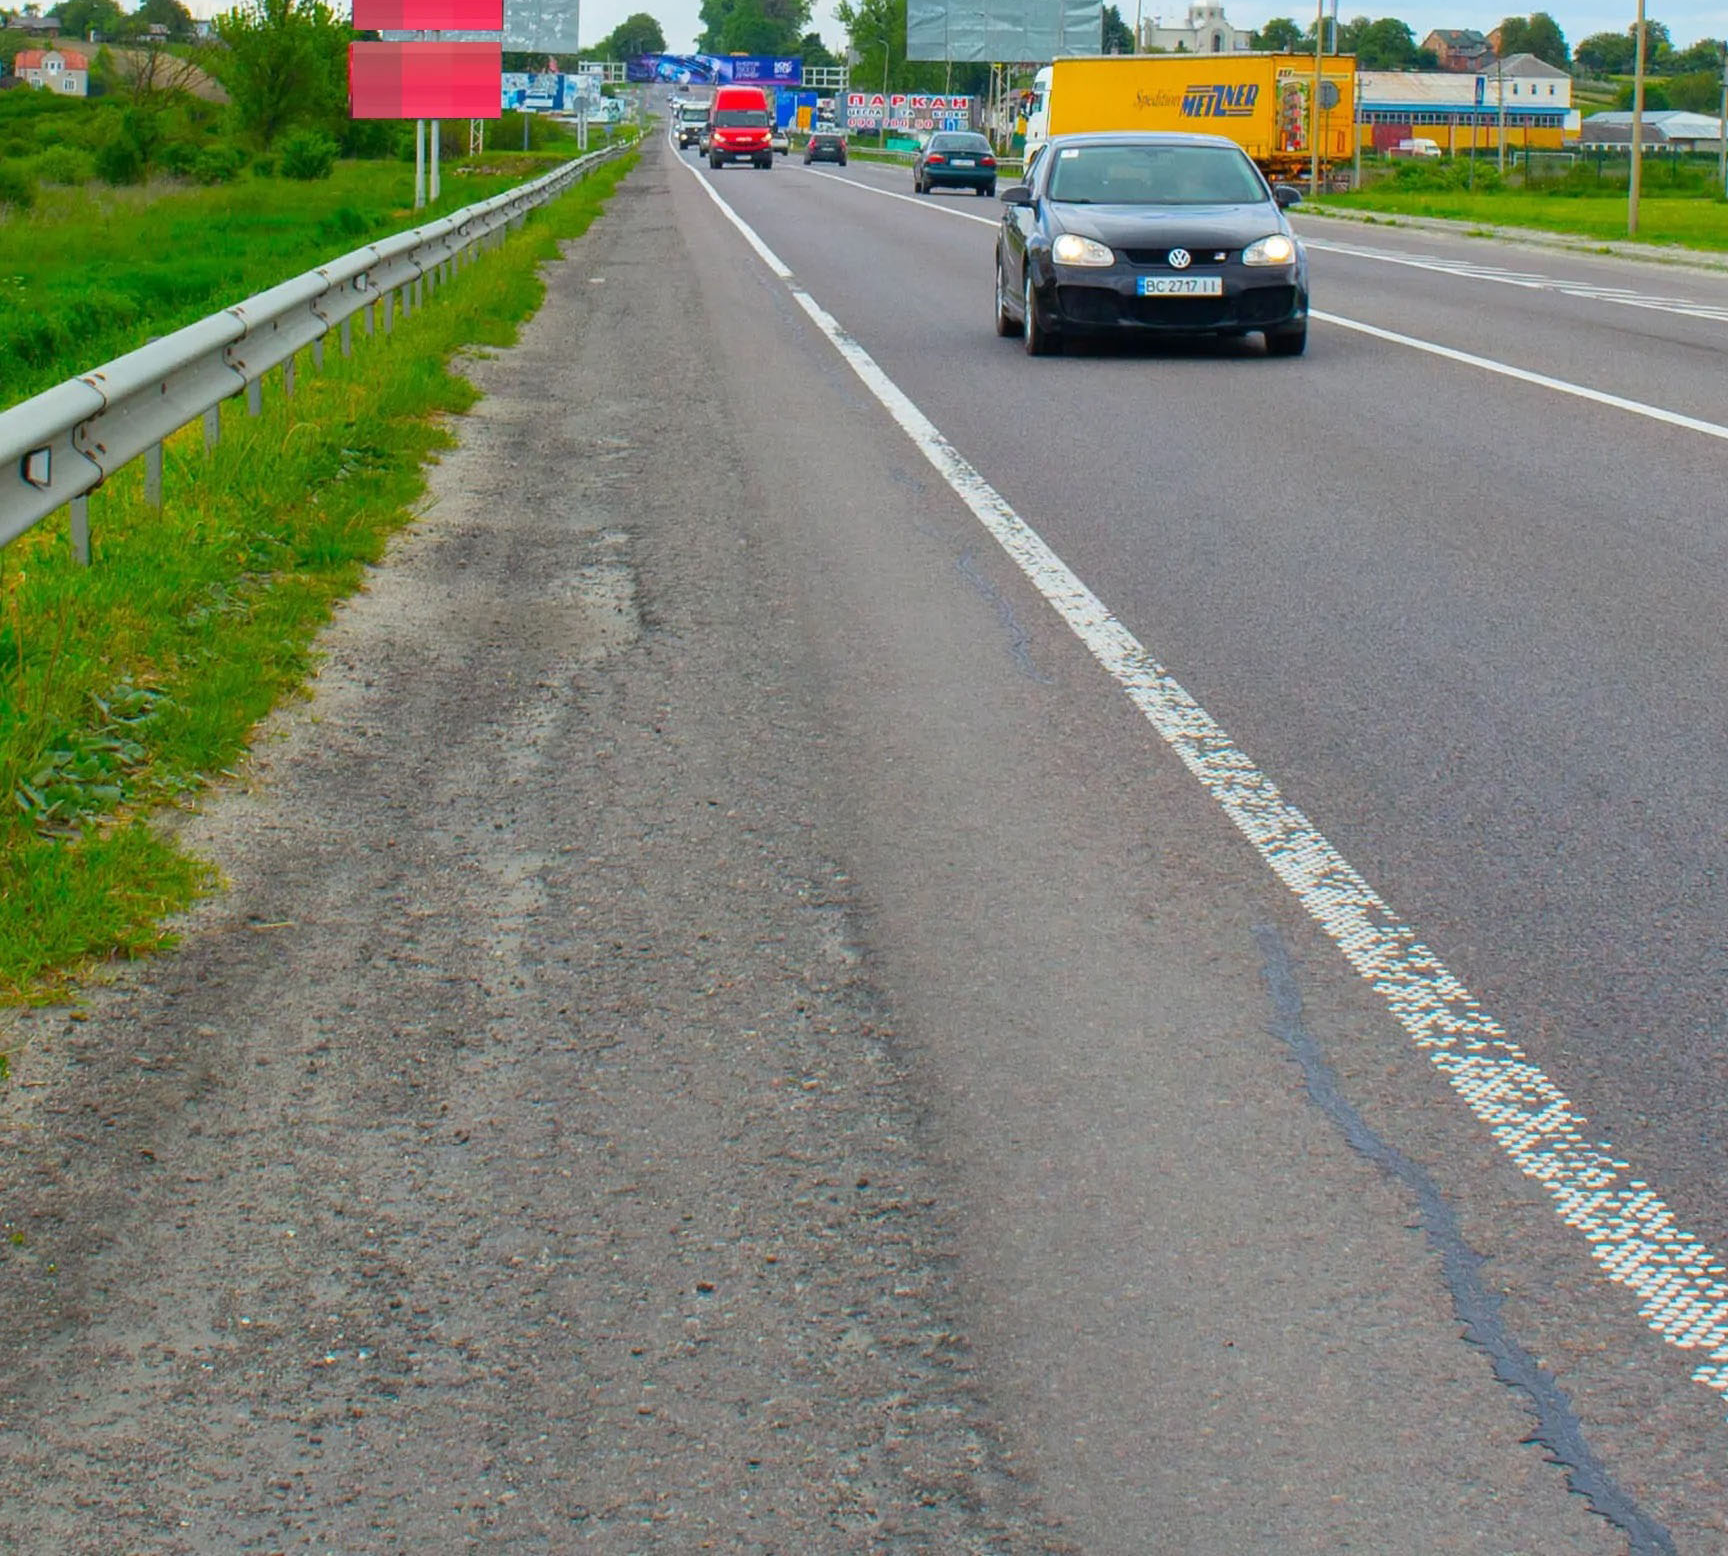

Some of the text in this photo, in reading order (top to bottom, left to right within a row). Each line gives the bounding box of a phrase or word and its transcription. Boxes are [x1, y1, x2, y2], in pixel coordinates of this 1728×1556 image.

[848, 94, 968, 109] ПАРКАН
[1181, 84, 1259, 117] METZNER
[1146, 280, 1165, 293] BC
[1168, 280, 1198, 293] 2717
